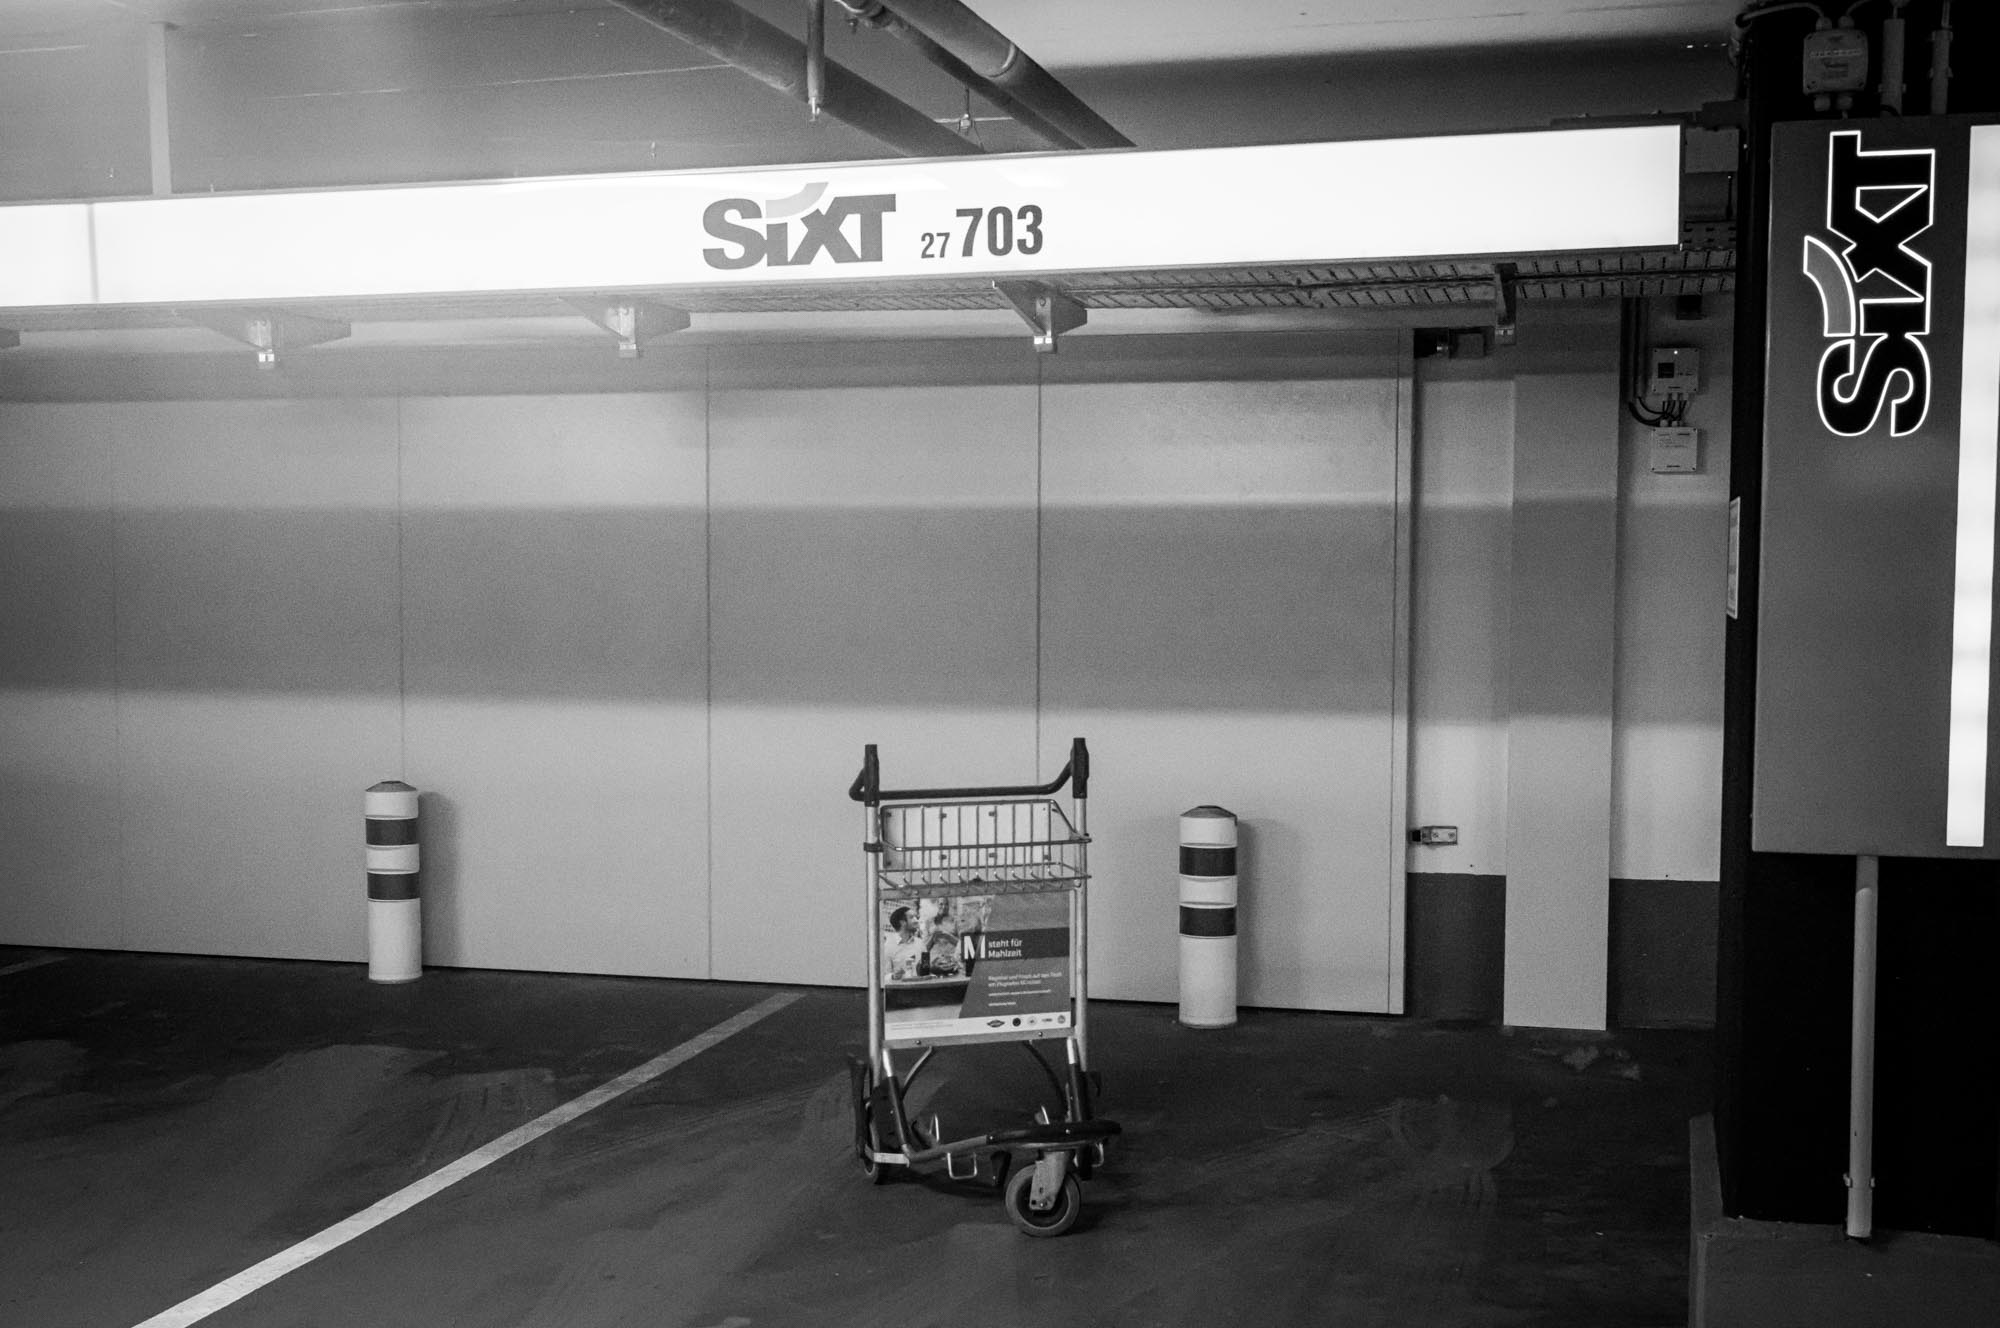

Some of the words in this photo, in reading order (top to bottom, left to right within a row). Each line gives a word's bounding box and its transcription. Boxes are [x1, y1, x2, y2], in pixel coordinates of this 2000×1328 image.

[920, 232, 951, 259] 27
[955, 204, 1043, 257] 703
[963, 934, 986, 959] M
[988, 940, 1009, 949] steht
[1010, 938, 1023, 948] für
[988, 949, 1022, 958] Mahlzeit
